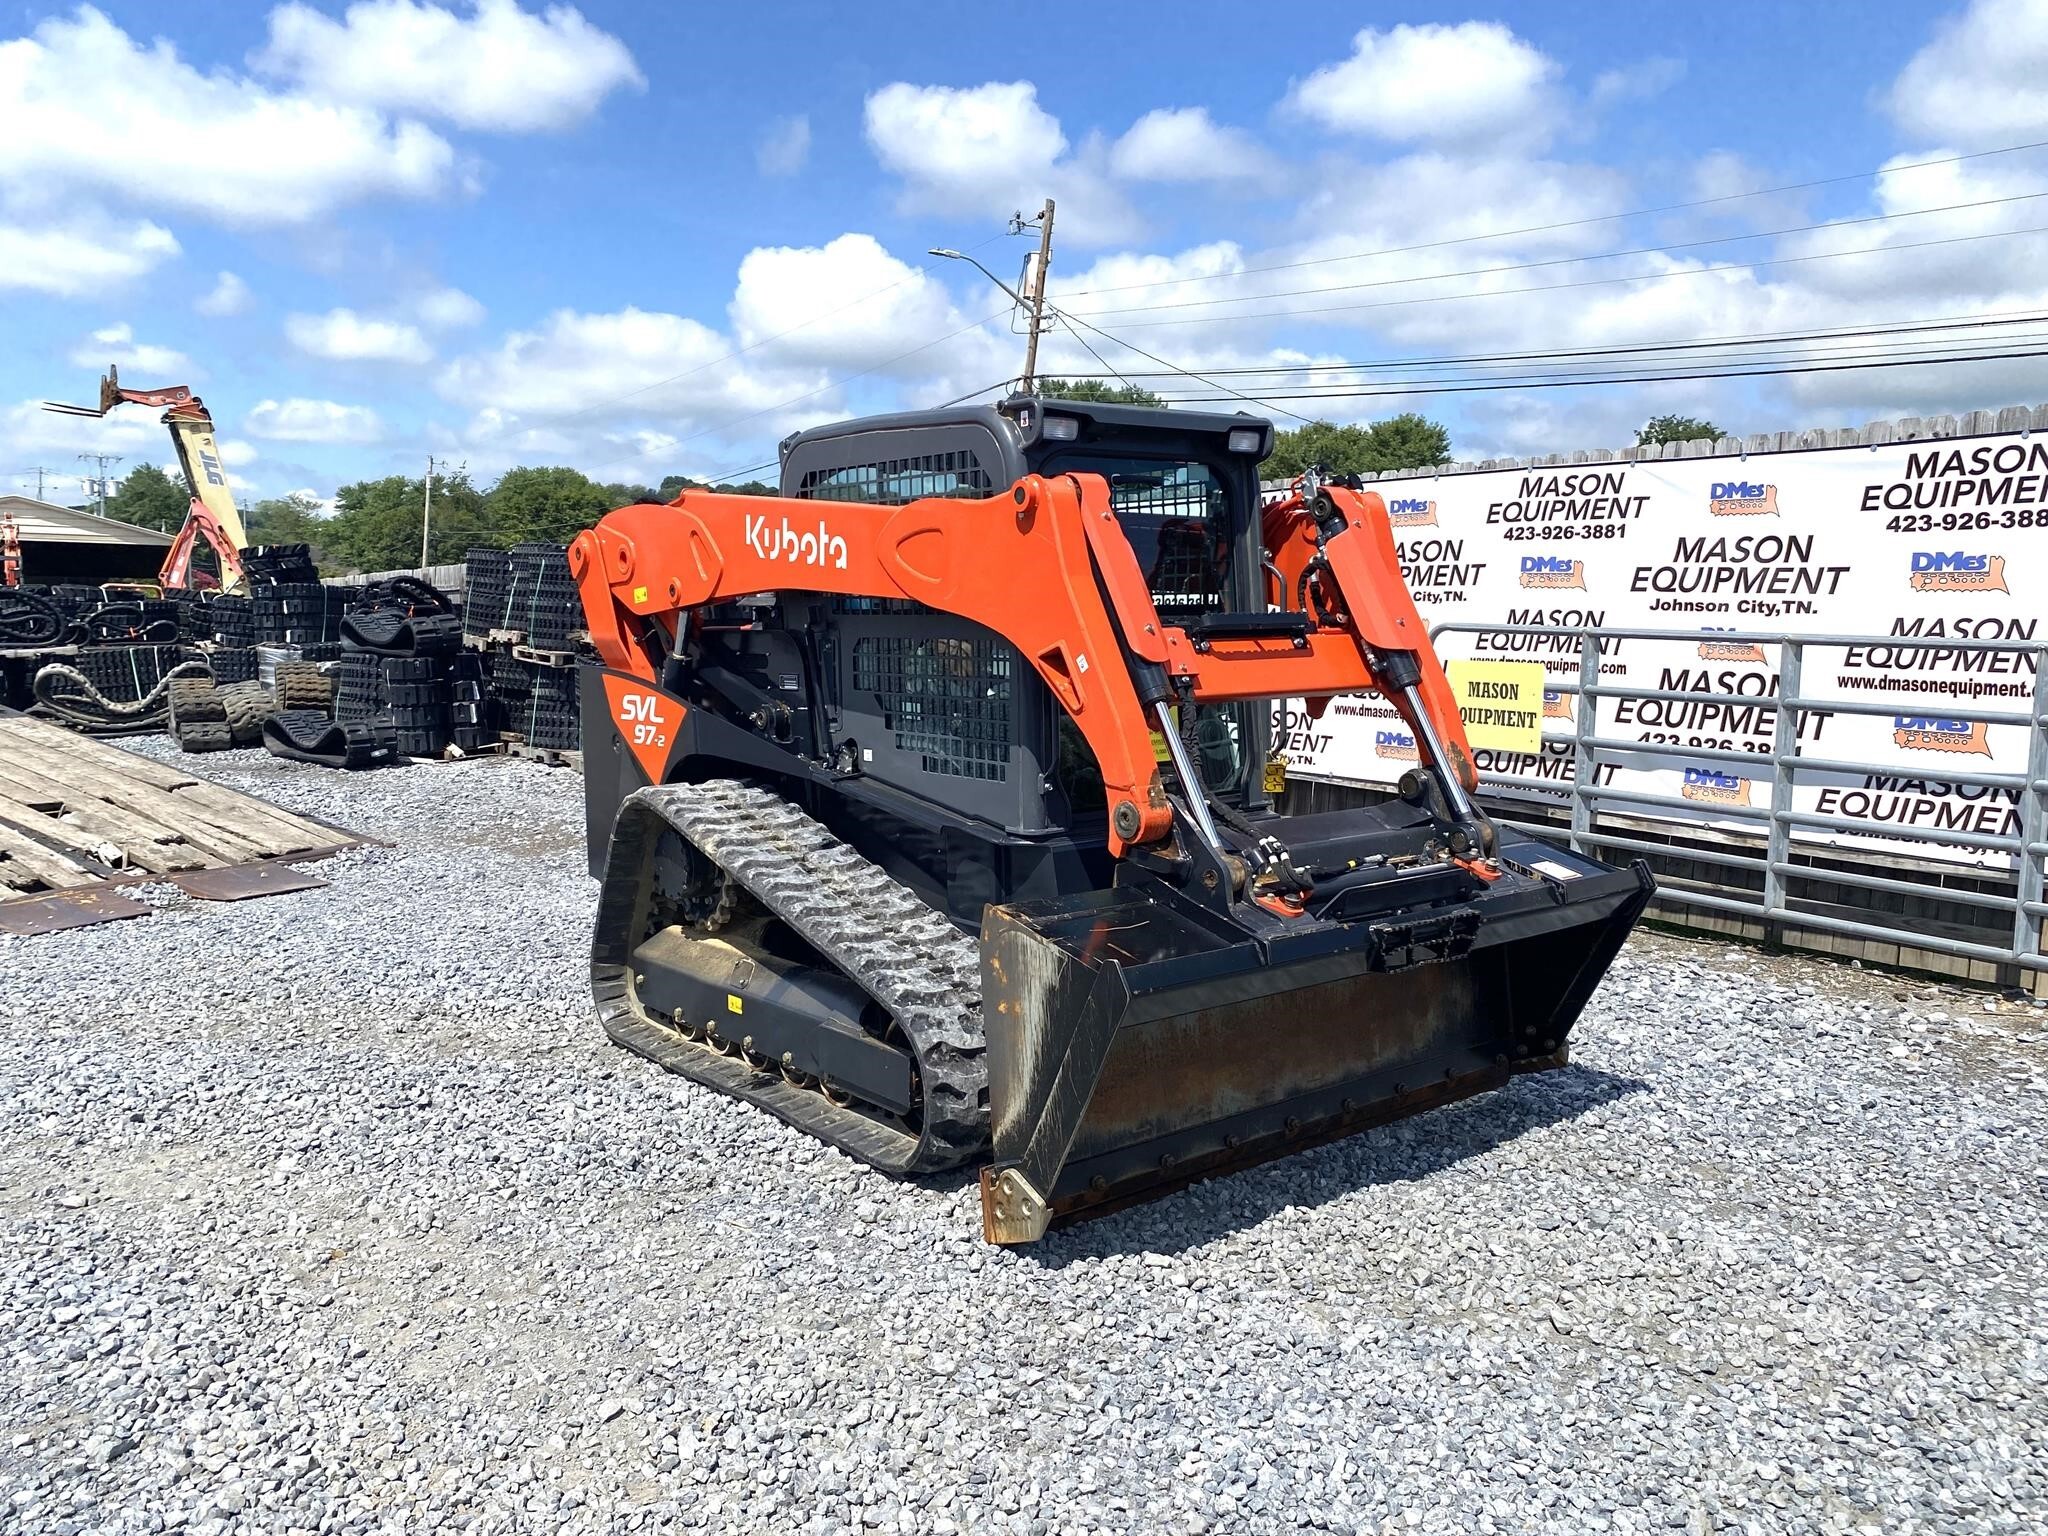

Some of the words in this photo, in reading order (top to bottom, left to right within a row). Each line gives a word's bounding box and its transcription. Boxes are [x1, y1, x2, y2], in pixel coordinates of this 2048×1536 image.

[199, 449, 224, 486] JLG
[1906, 443, 2048, 479] MASON
[1519, 472, 1625, 498] MASON
[1860, 473, 2048, 511] EQUIPME
[1486, 496, 1650, 524] EQUIPMENT
[1886, 508, 2048, 532] 423-926-388
[745, 514, 848, 569] Kubota
[1504, 524, 1626, 541] 423-926-3881
[1396, 539, 1464, 563] ASON
[1673, 535, 1814, 563] MASON
[1401, 564, 1487, 587] PMENT
[1631, 566, 1850, 595] EQUIPMENT
[1507, 609, 1605, 628] MASON
[1649, 598, 1729, 613] Johnson
[1736, 600, 1818, 617] City,TN.
[1890, 617, 2038, 640] MASON
[1843, 646, 2037, 674] EQUIPMEN
[1468, 680, 1520, 701] MASON
[1837, 674, 2036, 699] www.dmasonequipment.
[620, 694, 665, 724] SVL
[1272, 710, 1314, 731] SON
[1459, 706, 1537, 730] QUIPMENT
[1638, 731, 1802, 757] 423-926-381
[1472, 749, 1623, 786] QUIPMET
[1815, 788, 2024, 838] EQUIPMEN
